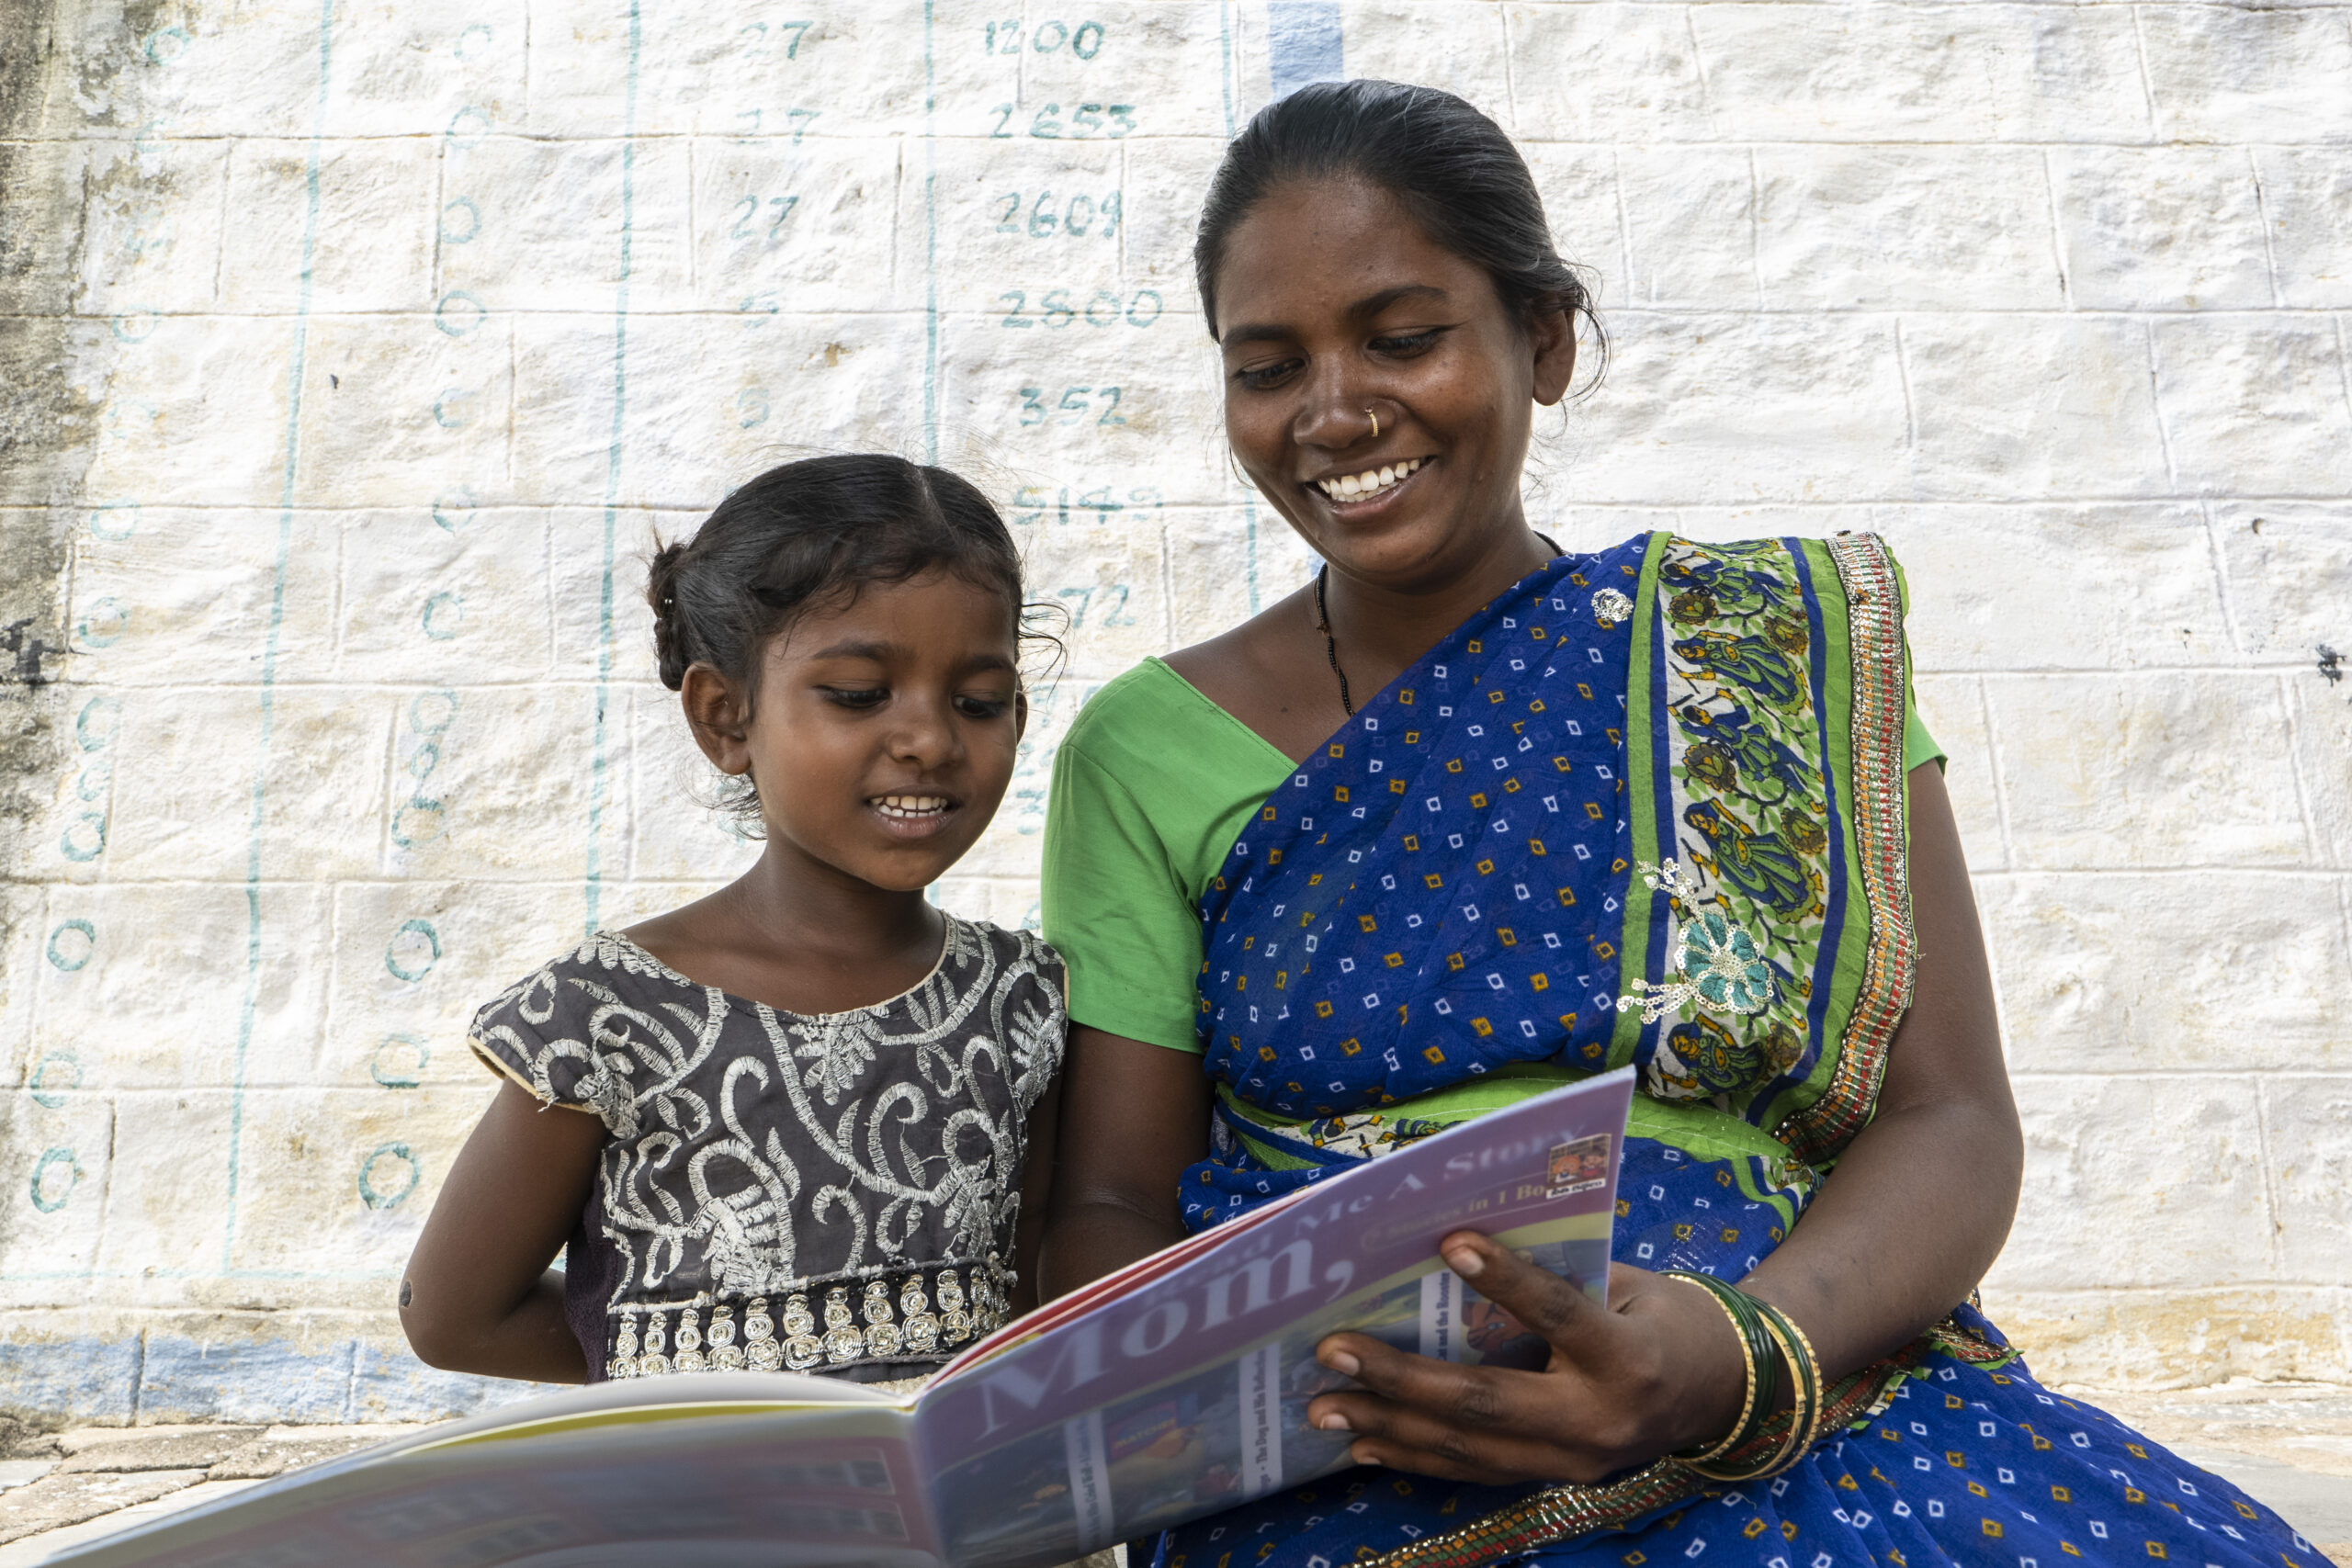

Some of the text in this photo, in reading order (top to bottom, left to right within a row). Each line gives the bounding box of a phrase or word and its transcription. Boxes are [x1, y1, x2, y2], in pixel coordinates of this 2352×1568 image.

[741, 20, 813, 60] 27
[985, 19, 1105, 62] 1200
[989, 102, 1136, 140] 2653
[730, 194, 800, 241] 27
[995, 189, 1123, 239] 2609
[1000, 288, 1163, 330] 2800
[1019, 386, 1126, 426] 352
[1387, 1172, 1428, 1202] A
[1468, 1196, 1490, 1217] in
[1516, 1183, 1546, 1202] Bo
[1435, 1271, 1451, 1310] Rooster
[980, 1238, 1356, 1435] Mom,
[1435, 1311, 1449, 1327] the
[1254, 1427, 1269, 1447] Dog
